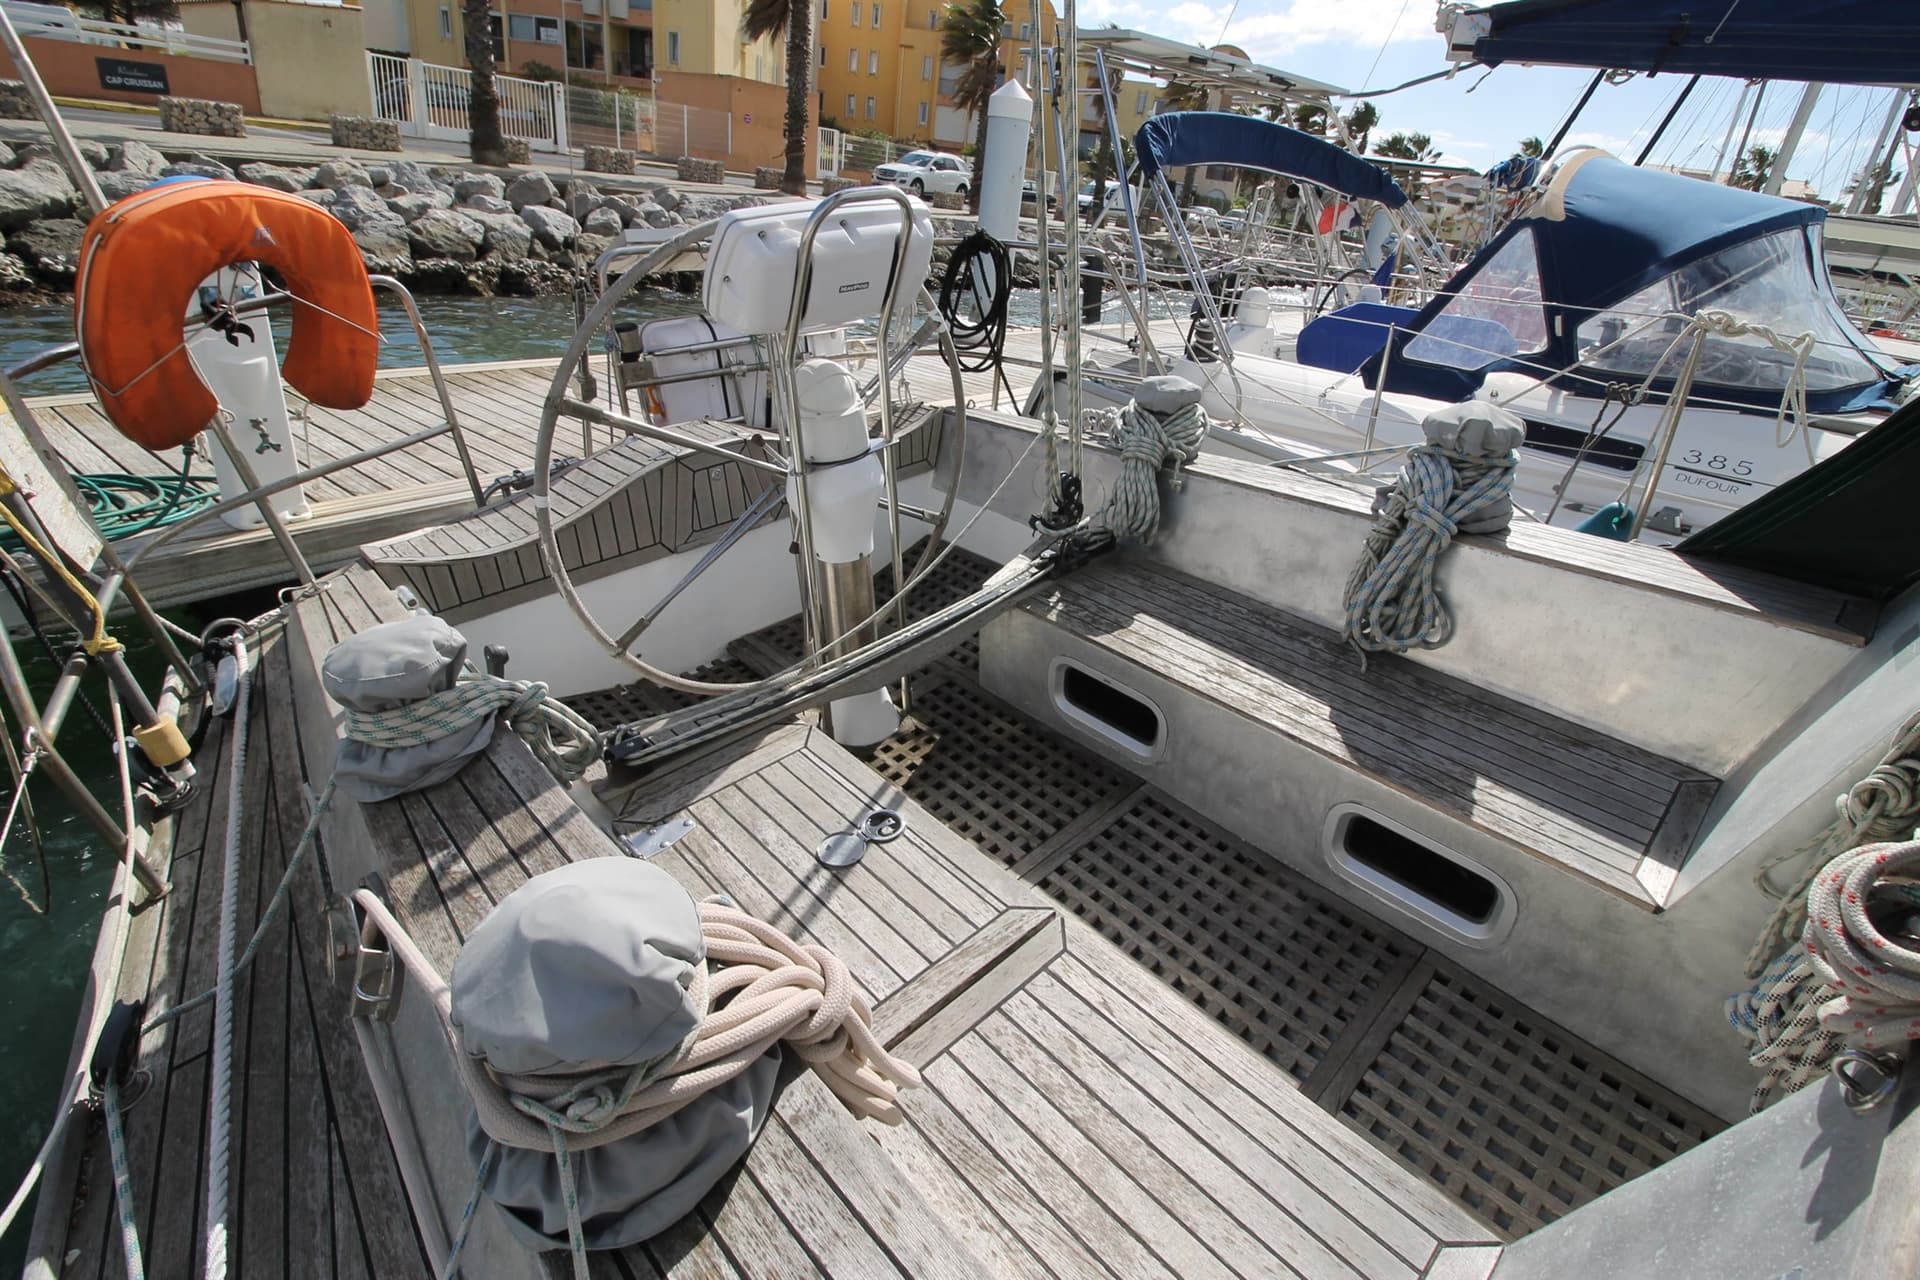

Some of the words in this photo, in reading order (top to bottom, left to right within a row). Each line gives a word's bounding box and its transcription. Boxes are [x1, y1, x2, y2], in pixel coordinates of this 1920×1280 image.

[105, 75, 122, 84] CAP
[1683, 449, 1754, 476] 385
[1675, 472, 1740, 495] DUFOUR
